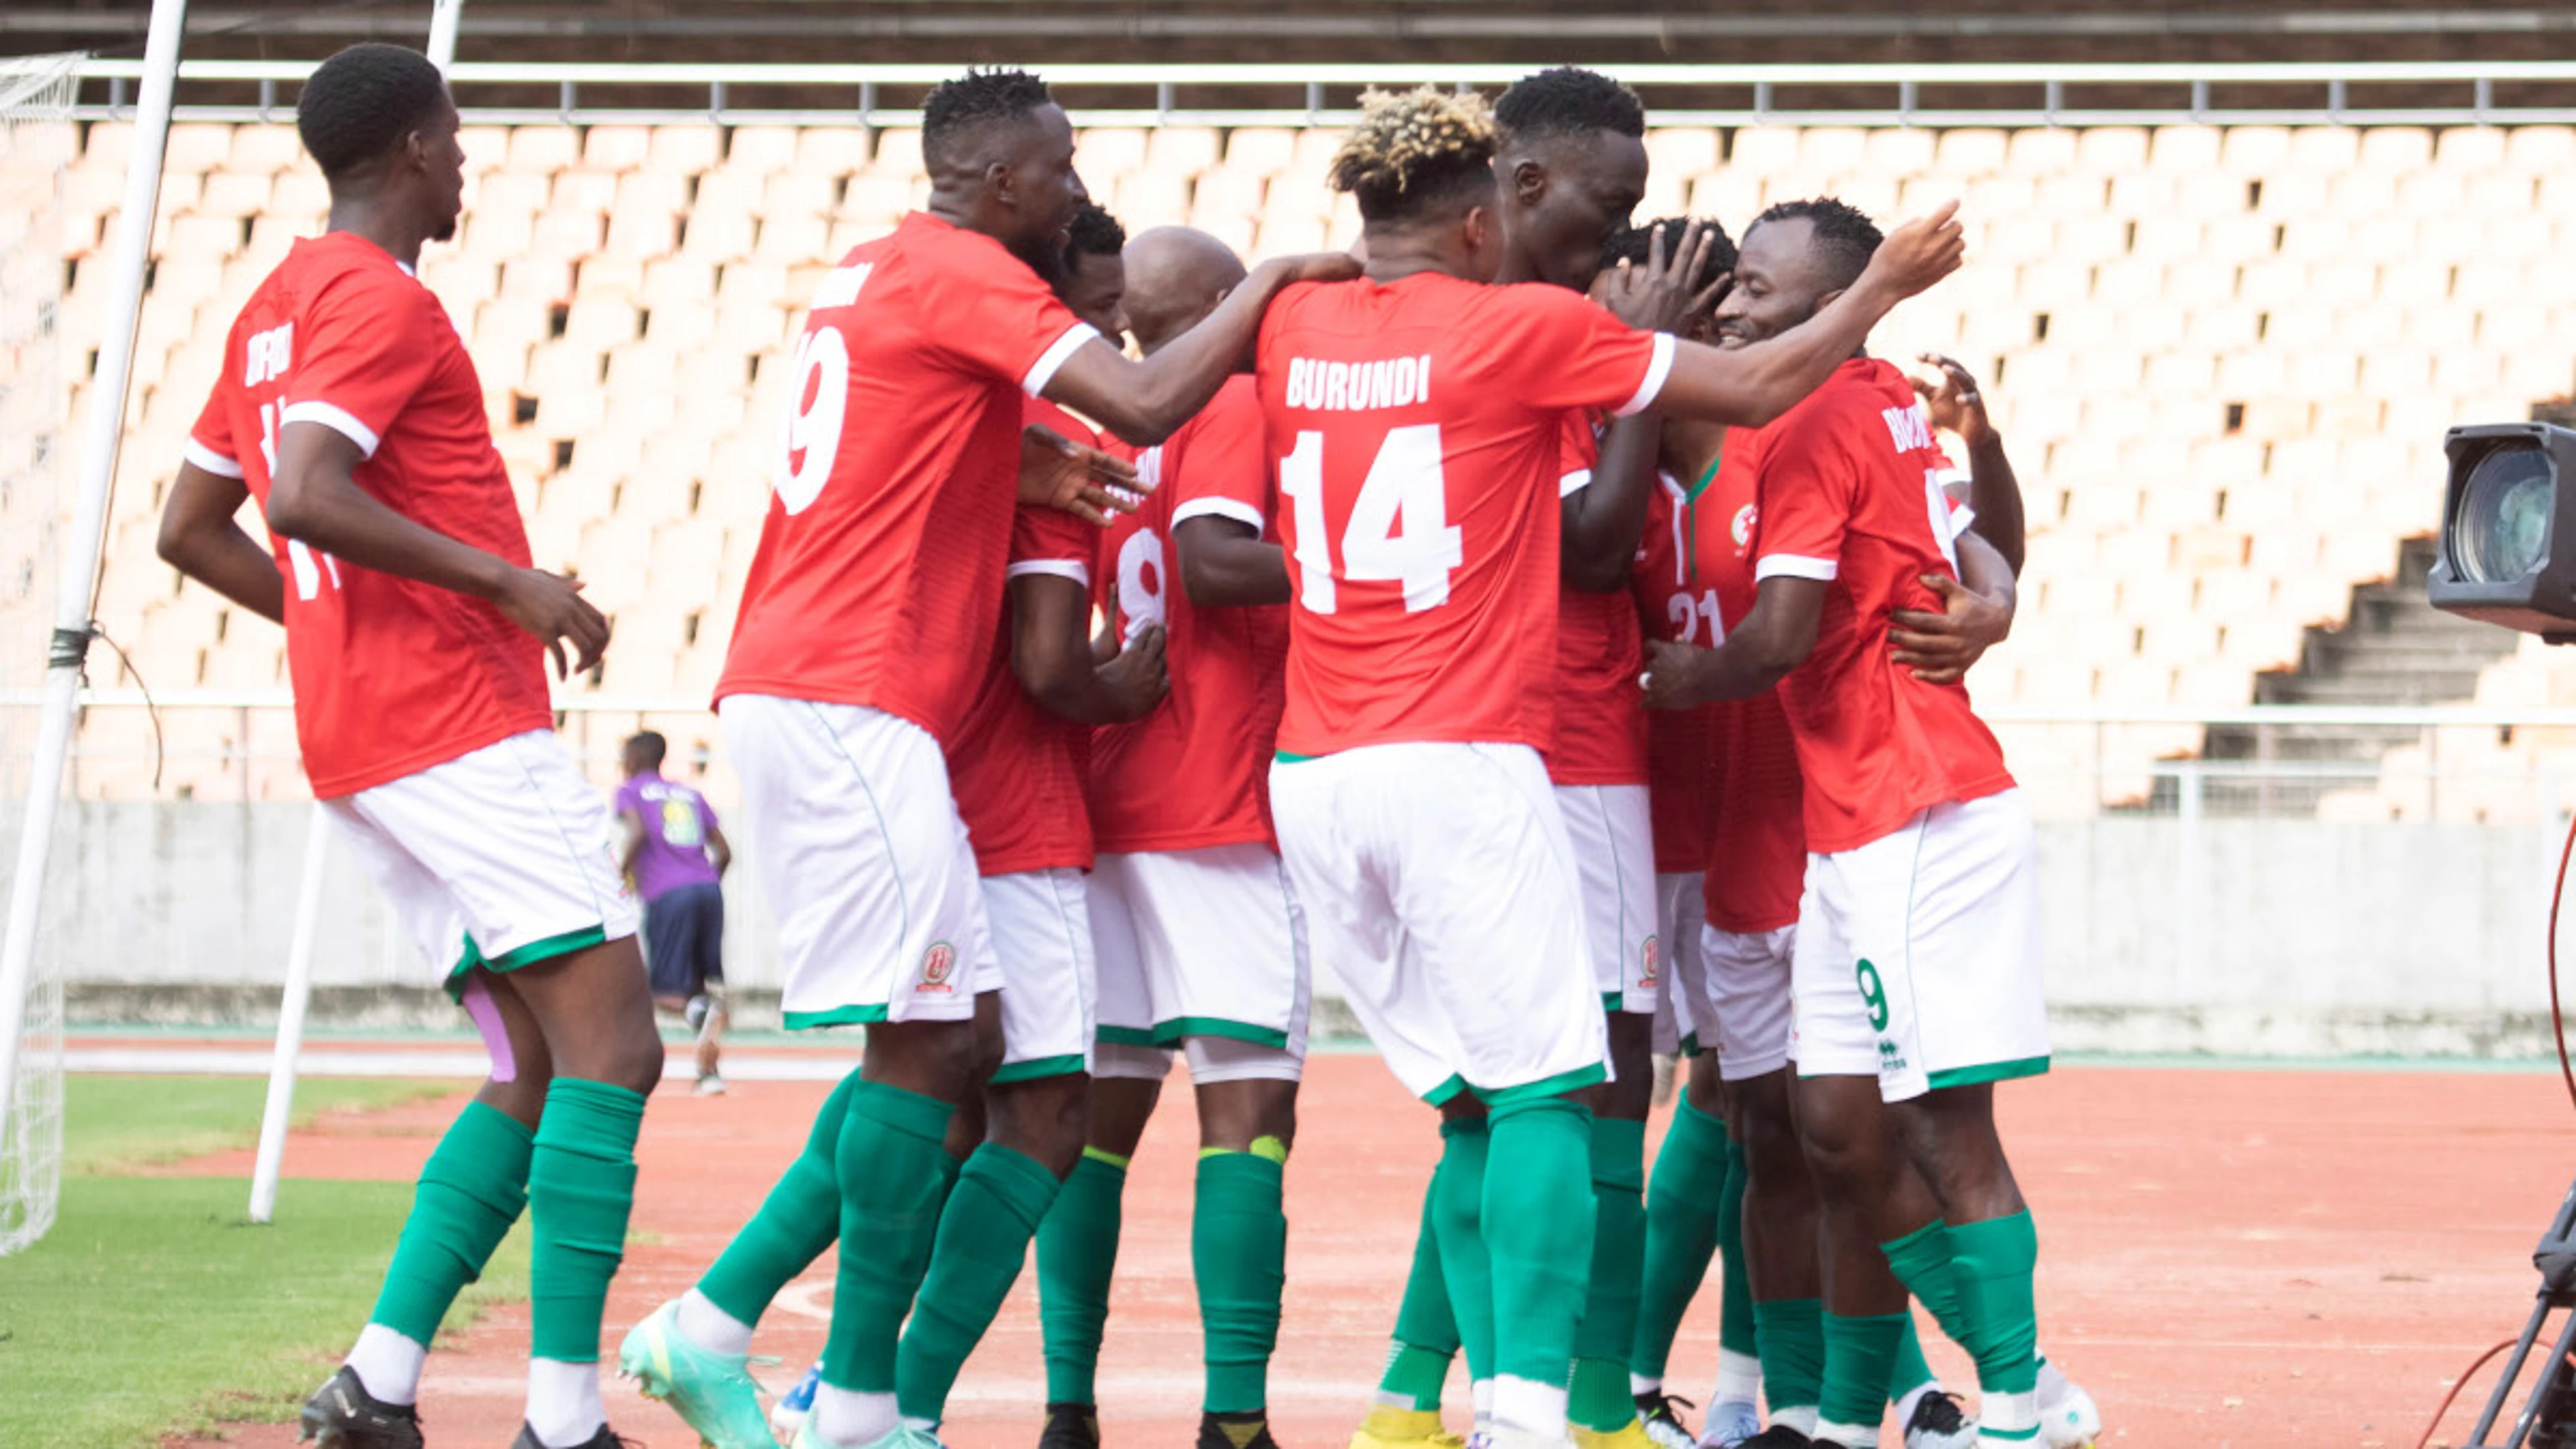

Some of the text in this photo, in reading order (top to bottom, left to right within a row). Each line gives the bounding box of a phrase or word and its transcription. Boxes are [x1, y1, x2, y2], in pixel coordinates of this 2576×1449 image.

[1285, 354, 1431, 411] BURUNDI
[1279, 423, 1462, 614] 14
[1667, 588, 1726, 649] 21
[1856, 957, 1889, 1033] 9
